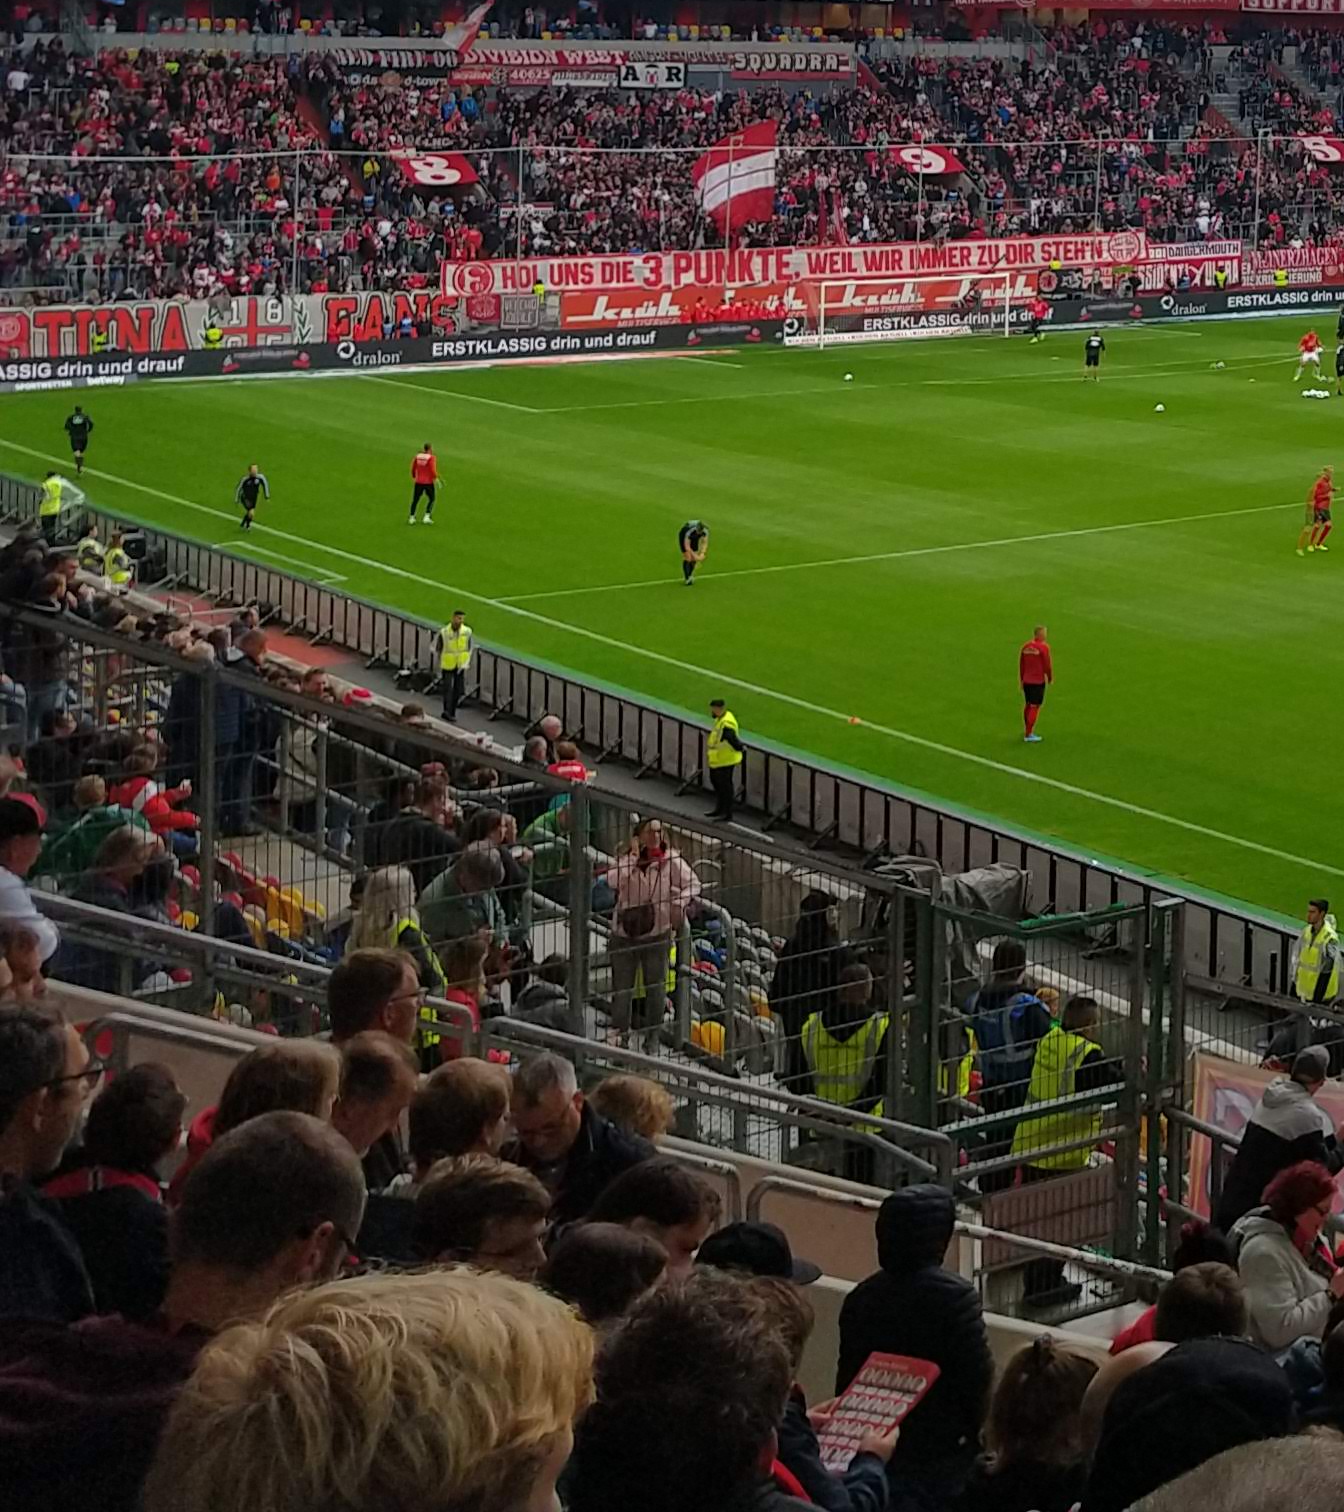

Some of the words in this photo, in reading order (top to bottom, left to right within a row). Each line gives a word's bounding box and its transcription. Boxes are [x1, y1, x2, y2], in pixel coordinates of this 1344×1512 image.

[733, 52, 840, 74] SQUADRA
[899, 147, 945, 173] 9
[410, 157, 462, 186] 8
[550, 262, 593, 286] UNS
[601, 260, 634, 284] DIE
[642, 254, 663, 287] 3
[673, 249, 801, 286] PUNKTE,
[806, 252, 858, 274] WEIL
[863, 249, 904, 272] WIR
[909, 244, 971, 270] IMMER
[977, 242, 1000, 266] ZU
[1005, 241, 1035, 265] DIR
[1203, 259, 1240, 287] ULRA
[1171, 304, 1206, 316] dralon
[1227, 290, 1309, 309] ERSTKLASSIG
[1312, 289, 1332, 302] drin
[864, 314, 961, 331] ERSTKLASSIG
[432, 337, 547, 357] ERSTKLASSIG
[551, 335, 581, 350] drin
[585, 333, 613, 349] und
[617, 331, 657, 348] drauf
[57, 360, 93, 378] drin
[99, 358, 132, 374] und
[138, 355, 185, 373] drauf
[352, 350, 401, 366] dralon
[87, 375, 125, 387] betway
